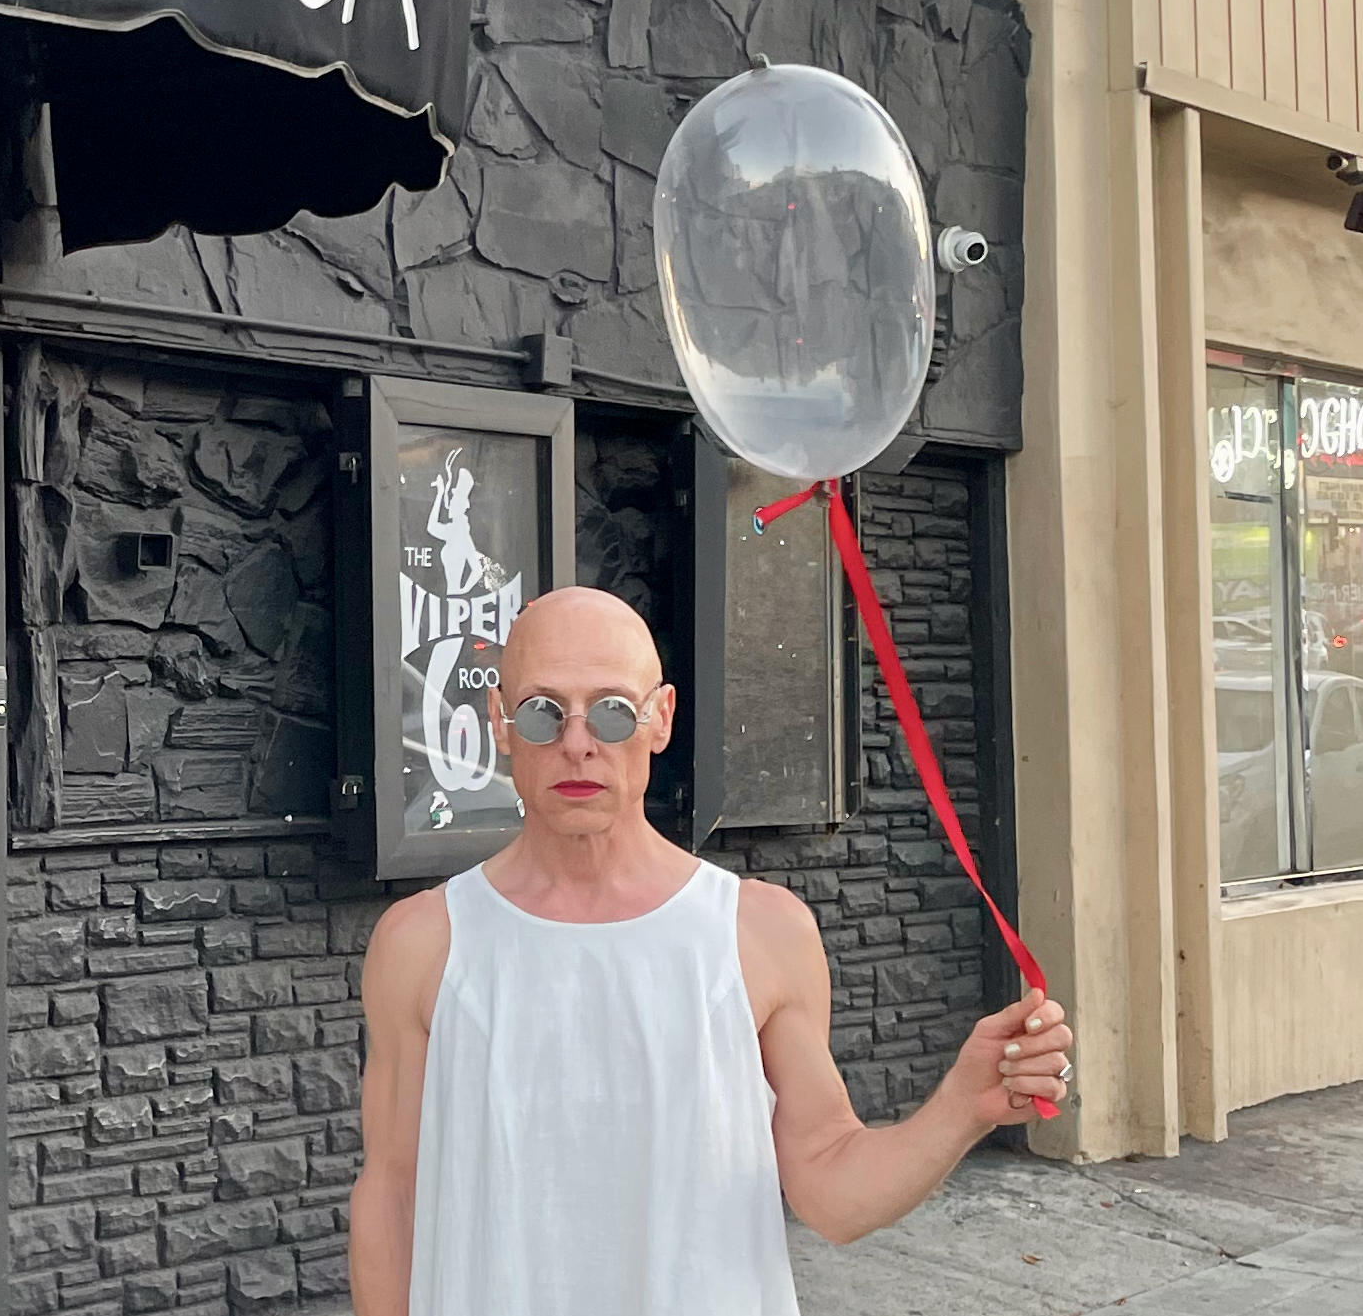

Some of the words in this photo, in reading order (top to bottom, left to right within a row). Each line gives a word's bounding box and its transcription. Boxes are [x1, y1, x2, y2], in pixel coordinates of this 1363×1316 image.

[404, 546, 433, 568] THE
[399, 571, 522, 660] VIPER
[458, 667, 500, 689] ROO
